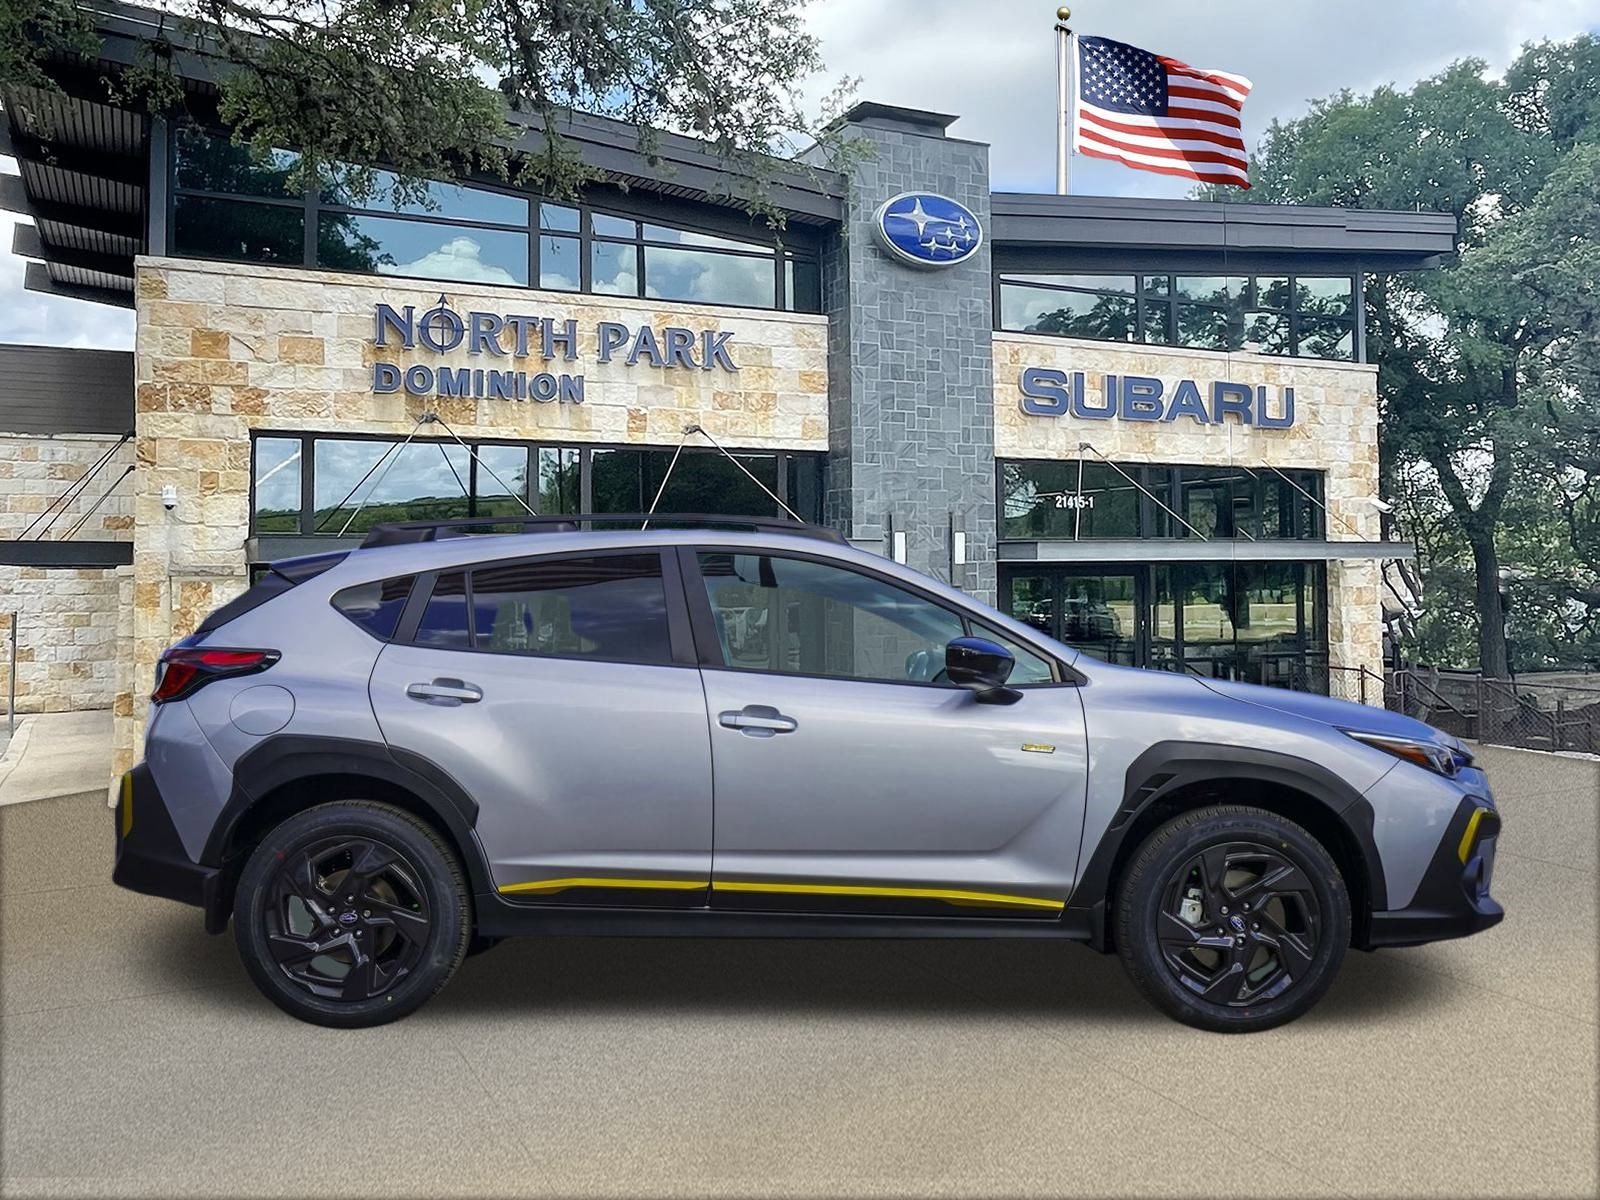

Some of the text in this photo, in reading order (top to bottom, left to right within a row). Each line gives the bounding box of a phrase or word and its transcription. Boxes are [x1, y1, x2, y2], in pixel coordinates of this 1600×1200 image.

[375, 299, 741, 373] NORTH PARK
[374, 362, 585, 404] DOMINION
[1019, 367, 1295, 430] SUBARU
